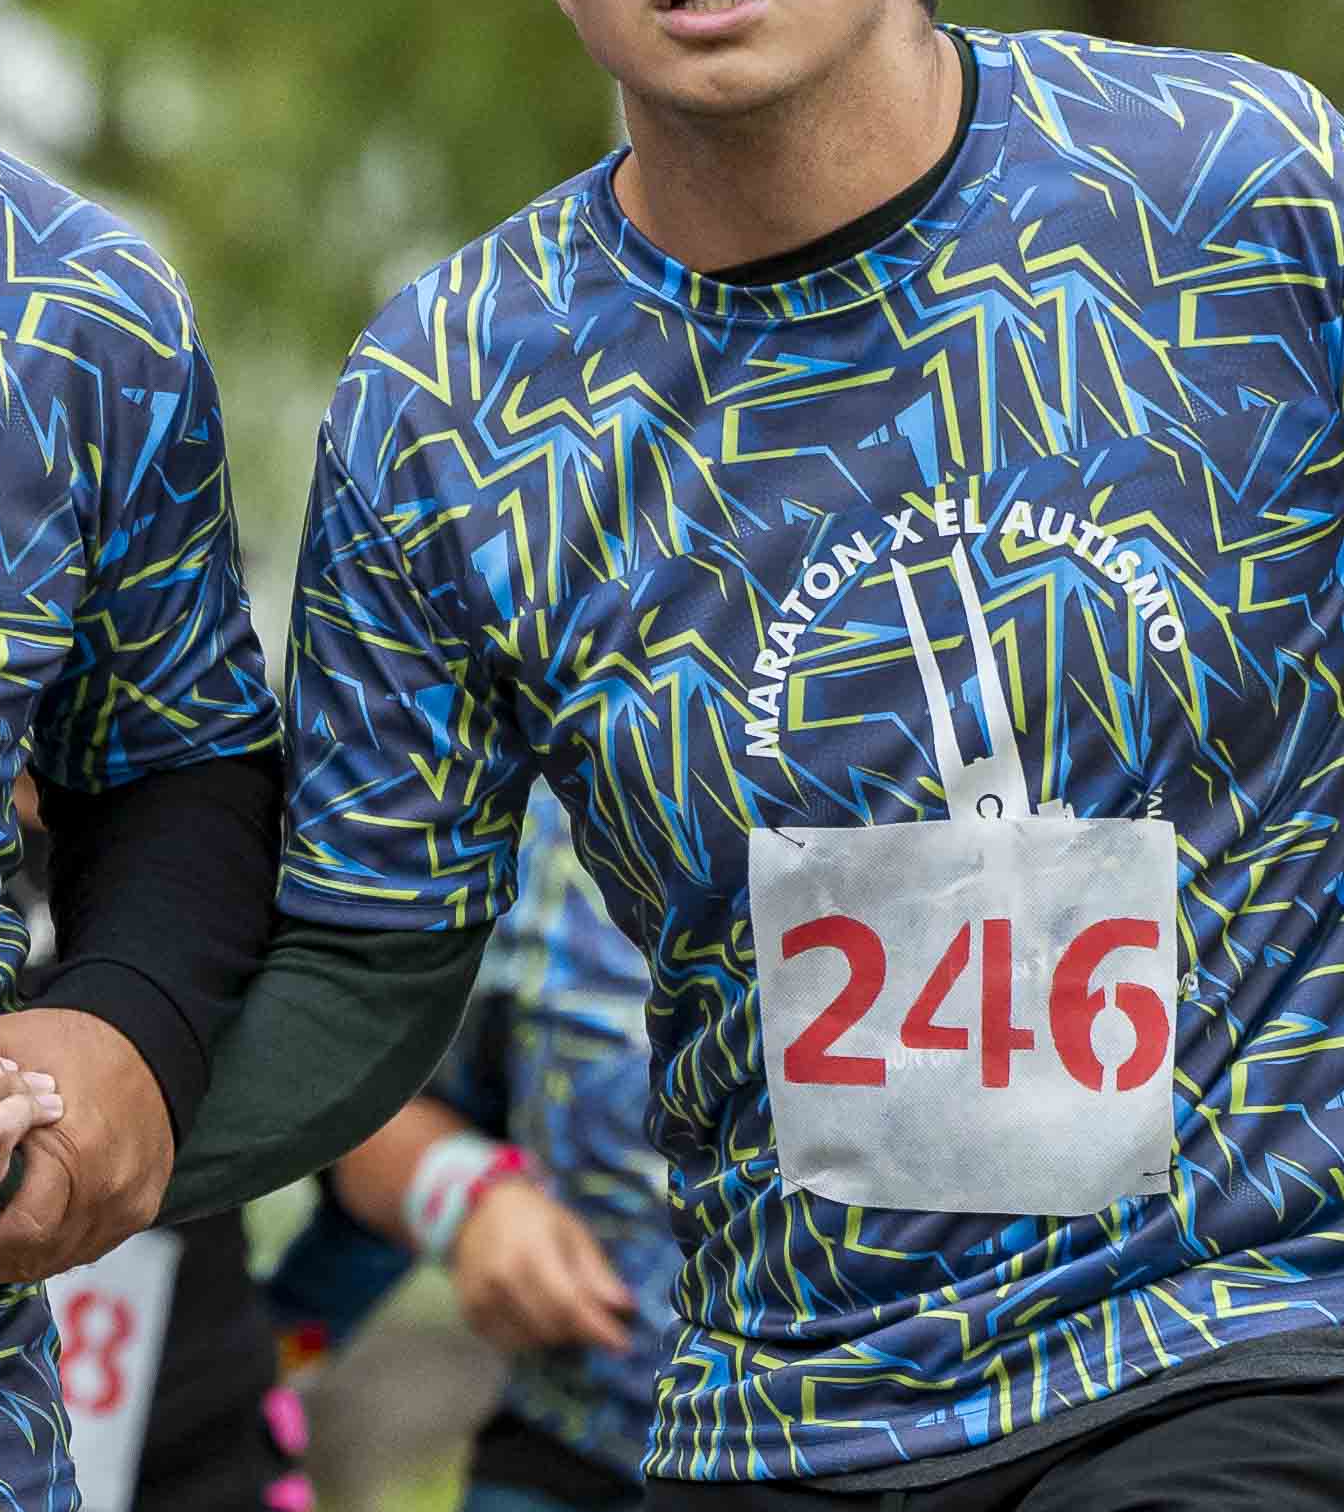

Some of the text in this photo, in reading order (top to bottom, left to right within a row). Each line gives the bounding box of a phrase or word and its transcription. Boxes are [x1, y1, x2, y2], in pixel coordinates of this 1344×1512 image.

[746, 498, 1186, 759] MARATÓN X EL AUTISMO
[781, 914, 1171, 1093] 246
